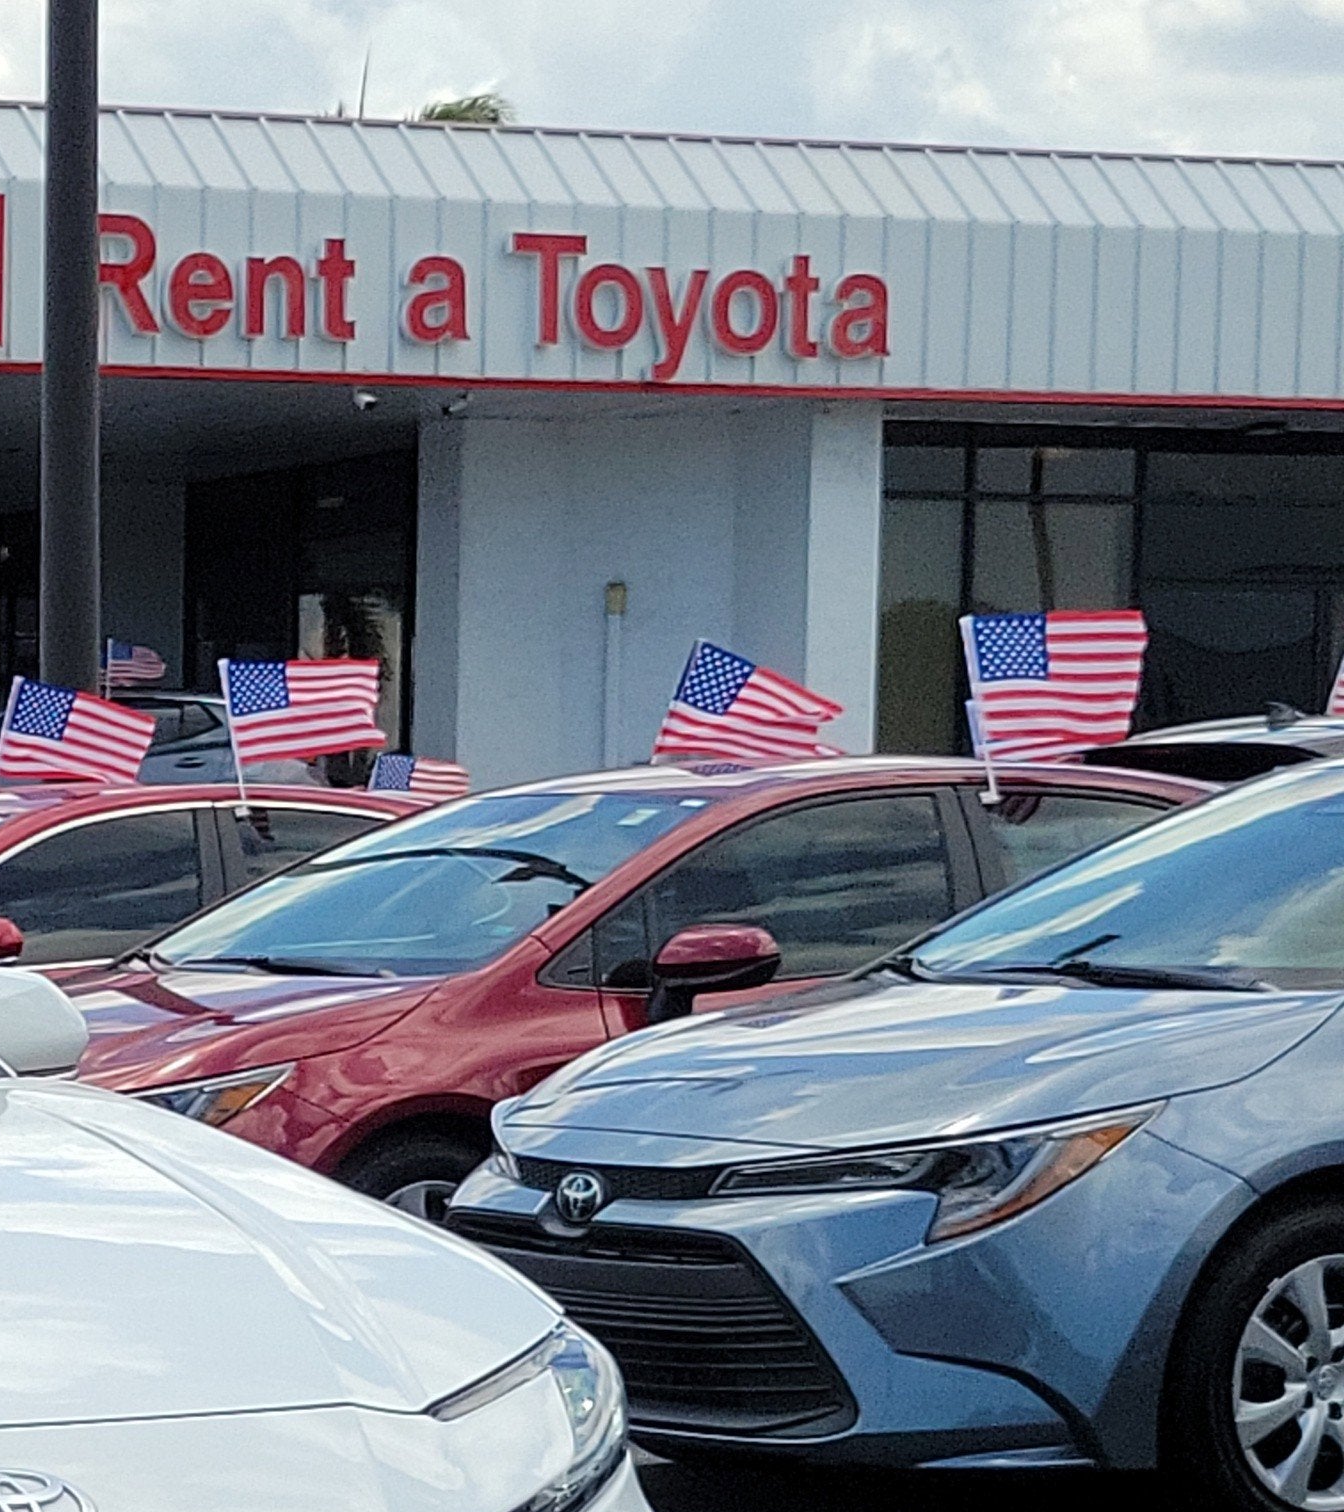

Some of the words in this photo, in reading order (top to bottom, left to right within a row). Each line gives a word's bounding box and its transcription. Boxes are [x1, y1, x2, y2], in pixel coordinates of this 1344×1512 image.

[98, 211, 357, 341] Rent
[404, 254, 471, 343] a
[511, 231, 892, 382] Toyota
